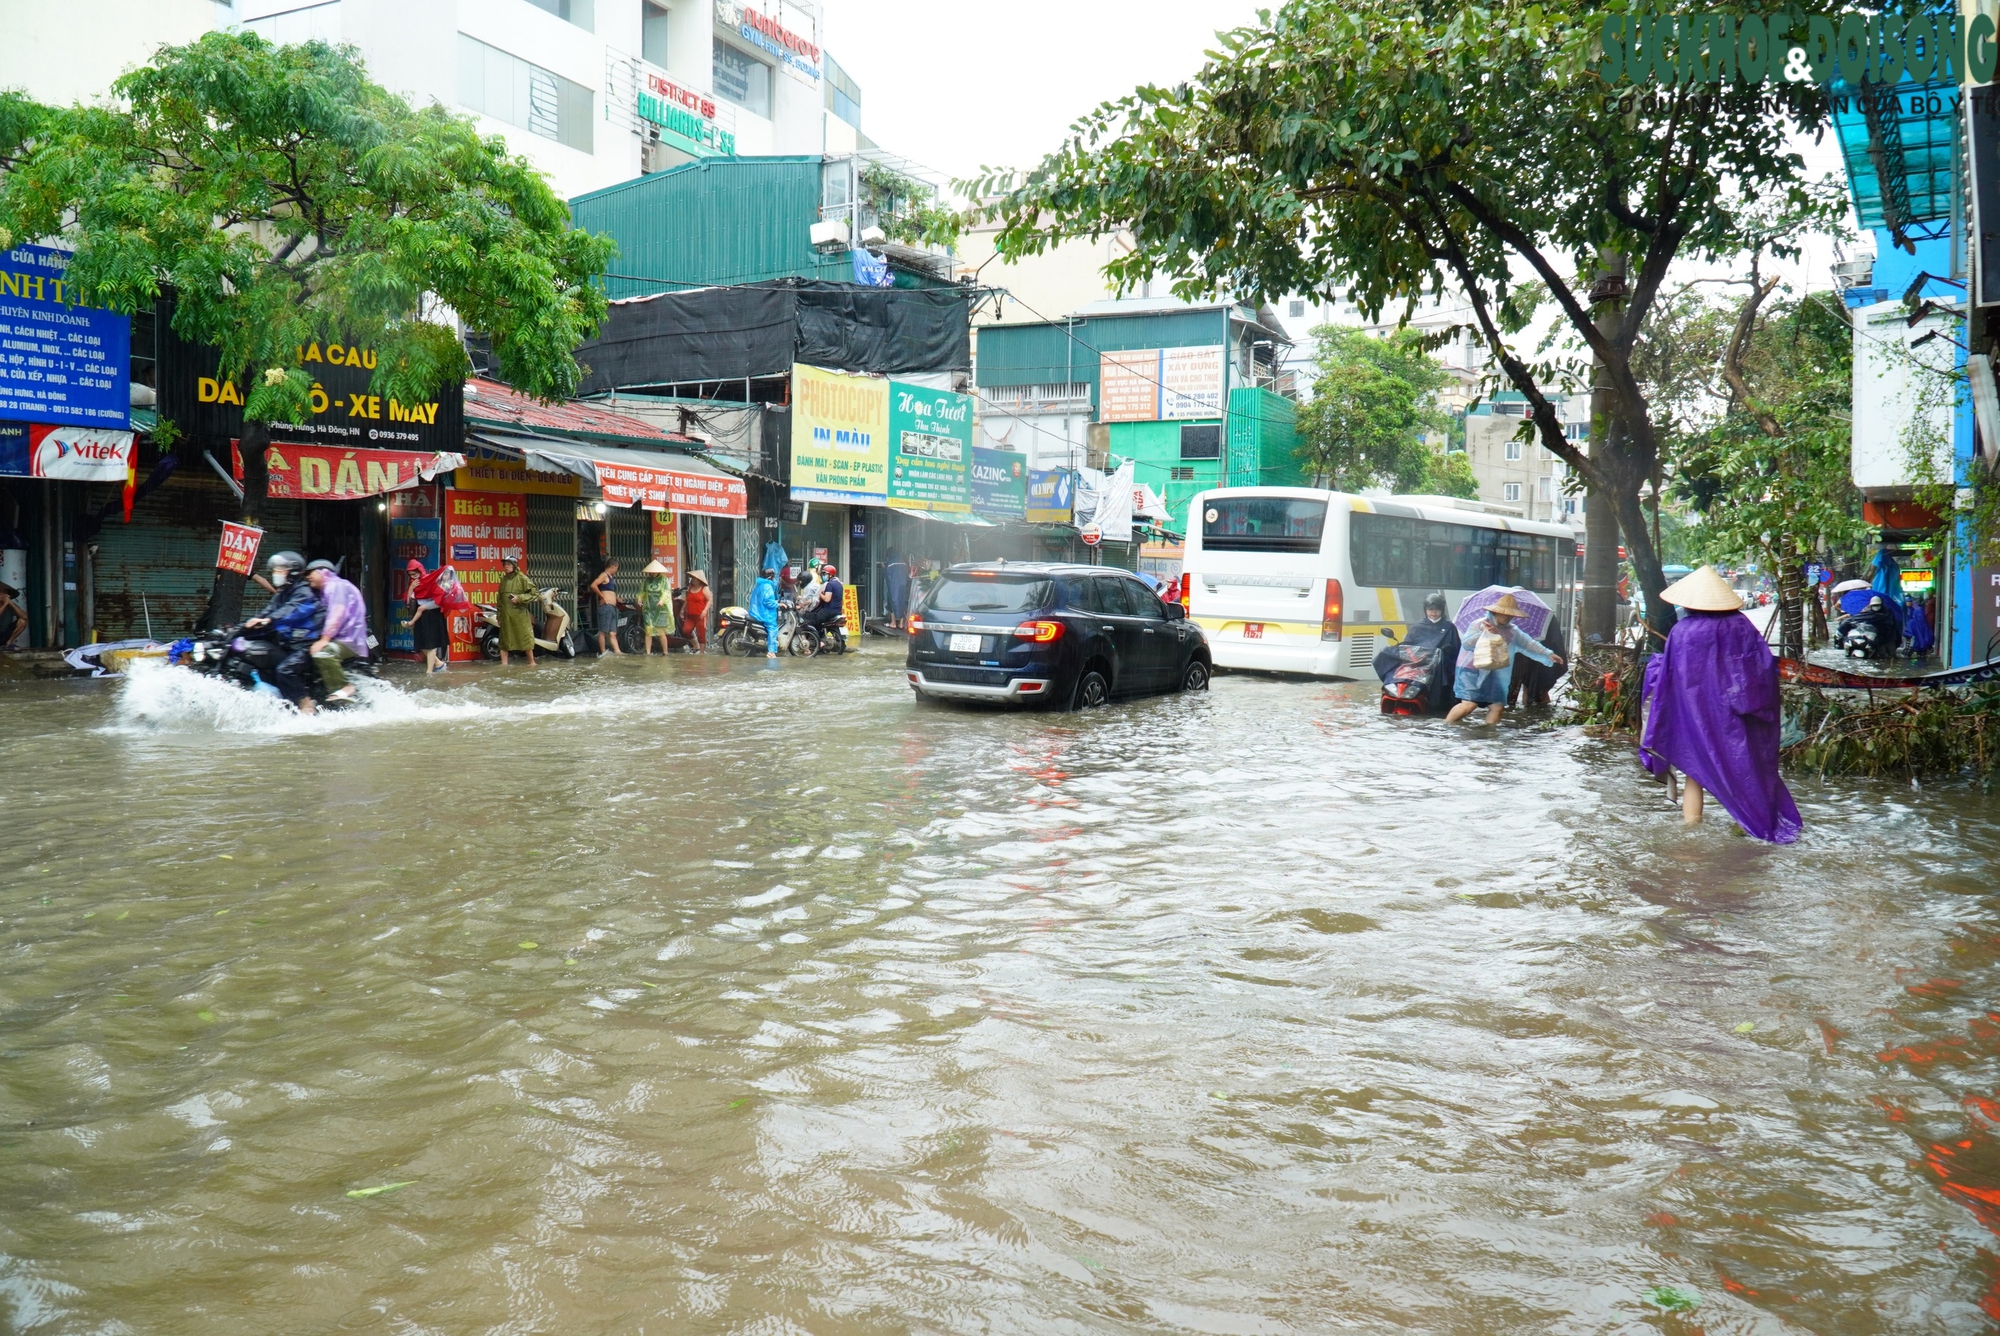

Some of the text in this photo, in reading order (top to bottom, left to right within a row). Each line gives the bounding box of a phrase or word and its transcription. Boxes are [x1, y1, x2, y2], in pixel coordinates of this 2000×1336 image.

[11, 248, 36, 265] CỬA
[32, 309, 54, 322] KINH
[14, 326, 101, 347] CÁCH NHIỆT CÁC LOẠI
[42, 344, 62, 356] INOX,
[72, 347, 87, 359] CÁC
[88, 350, 105, 362] LOẠI
[28, 356, 47, 368] HÌNH
[48, 360, 54, 369] U
[70, 362, 75, 371] V
[85, 363, 100, 374] CÁC
[101, 366, 117, 378] LOẠI
[11, 368, 27, 381] CỬA
[46, 373, 67, 386] NHỰA
[80, 376, 94, 388] CÁC
[95, 379, 112, 390] LOẠI
[37, 390, 47, 400] HÀ
[48, 391, 67, 402] ĐÔNG
[799, 378, 884, 426] PHOTOCOPY
[1139, 402, 1151, 410] 312
[348, 393, 381, 420] XE
[934, 398, 967, 422] Tươi
[270, 421, 294, 434] Phùng
[317, 425, 327, 434] Hà
[328, 425, 348, 438] Đông,
[349, 427, 360, 436] HN
[379, 430, 396, 440] 0936
[396, 431, 408, 441] 379
[408, 432, 420, 442] 495
[813, 427, 871, 454] IN MÀU
[299, 452, 400, 497] DÁN
[796, 454, 884, 475] ĐÁNH MÁY SCAN ÉP PLASTIC
[617, 469, 638, 481] CUNG
[638, 470, 654, 484] CẤP
[654, 472, 674, 487] THIẾT
[675, 476, 683, 489] BỊ
[683, 476, 707, 490] NGÀNH
[816, 472, 866, 488] VĂN PHÒNG PHẨM
[394, 488, 432, 507] HÀ
[607, 483, 730, 510] THIẾT SINH KIM KHÍ TỔNG HỢP
[454, 497, 521, 517] Hiếu Hà
[659, 511, 672, 522] 121
[450, 521, 524, 542] CUNG CẤP THIẾT BỊ
[764, 516, 778, 528] 125
[854, 524, 865, 533] 127
[223, 530, 258, 554] DÁN
[481, 543, 500, 562] ĐIỆN
[469, 568, 483, 584] KHÍ
[1221, 575, 1293, 586] HYUNDAI
[845, 588, 854, 632] SCAN
[452, 642, 465, 653] 121
[959, 635, 971, 643] 30G
